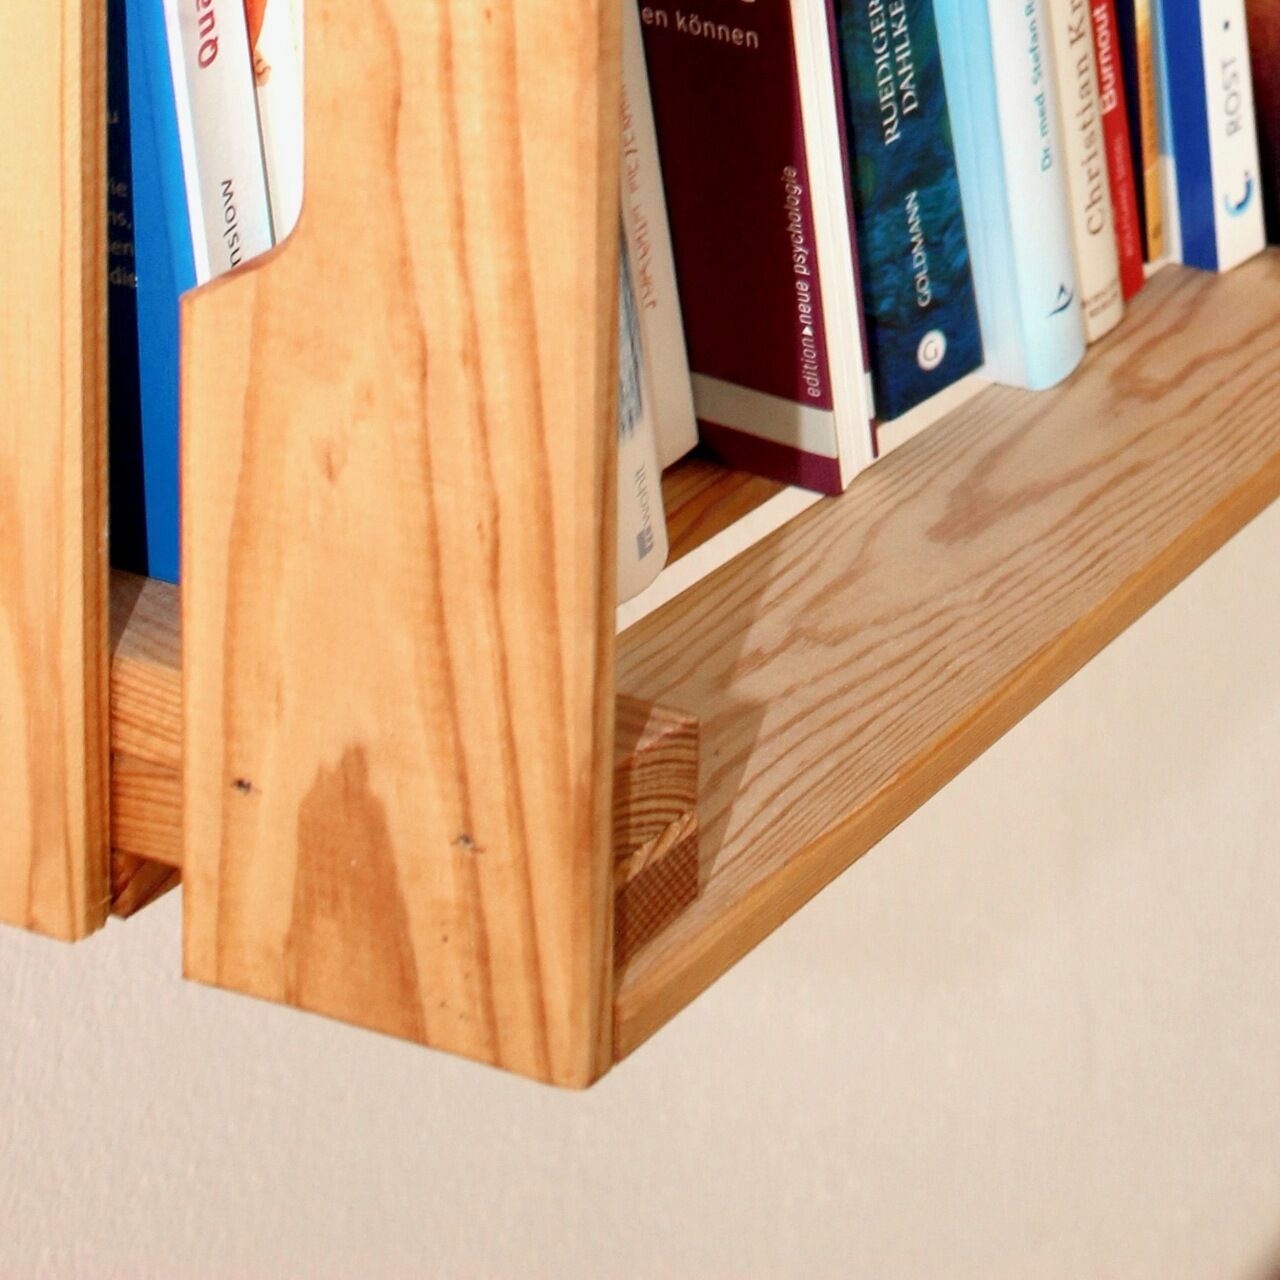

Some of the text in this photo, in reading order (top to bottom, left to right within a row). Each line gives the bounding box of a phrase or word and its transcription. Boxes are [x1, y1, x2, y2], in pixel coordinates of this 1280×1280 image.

[676, 9, 760, 49] können
[1093, 2, 1118, 116] Burnout
[1075, 54, 1105, 235] Christian
[1220, 55, 1242, 137] ROST
[781, 165, 811, 276] psychologie
[905, 189, 932, 308] GOLDMANN
